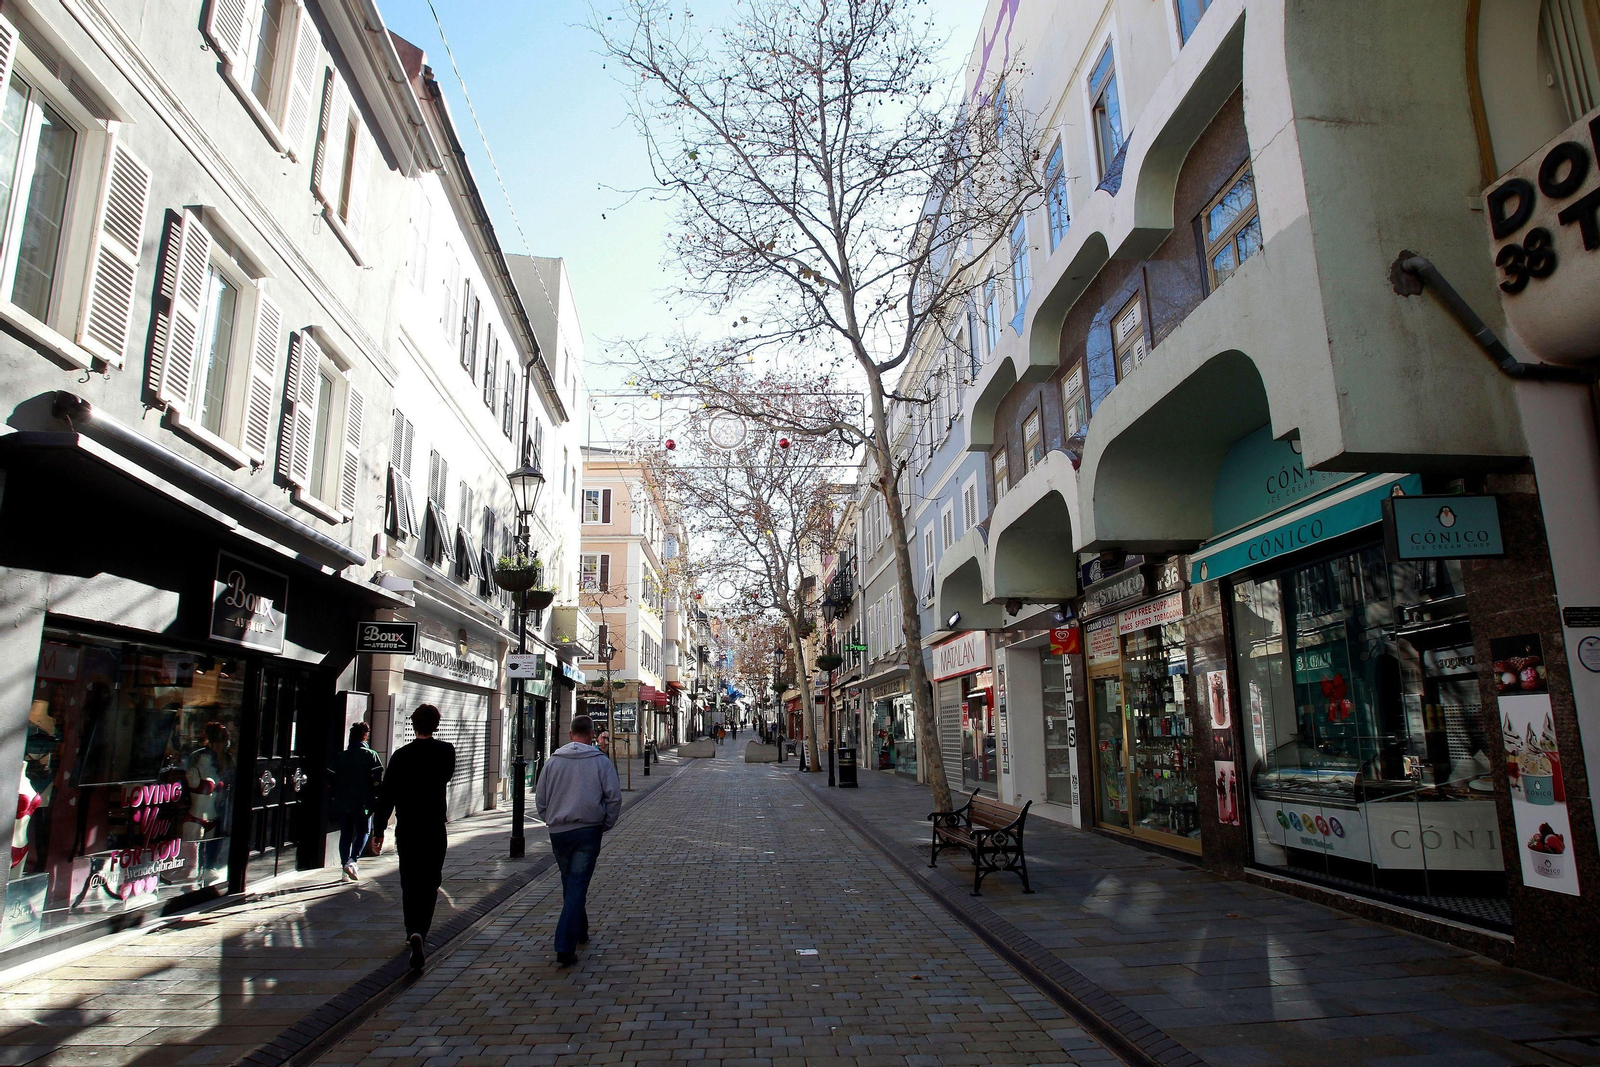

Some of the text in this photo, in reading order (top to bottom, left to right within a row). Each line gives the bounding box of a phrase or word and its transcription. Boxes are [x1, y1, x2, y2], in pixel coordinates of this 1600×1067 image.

[1495, 227, 1557, 294] 38
[1285, 479, 1315, 496] CREAM
[1248, 519, 1323, 561] CÓNICO
[1410, 530, 1489, 544] CÓNICO
[225, 570, 277, 627] Boux
[1124, 596, 1181, 622] DUTY FREE SUPPLIES
[234, 617, 266, 634] AVENUE
[364, 626, 407, 645] Boux
[1086, 621, 1102, 632] GRAND
[1102, 616, 1116, 627] OASIS
[1135, 617, 1152, 628] SPIRITS
[940, 639, 975, 673] MATALAN
[121, 782, 182, 809] LOVING
[111, 838, 181, 872] FOR YOU
